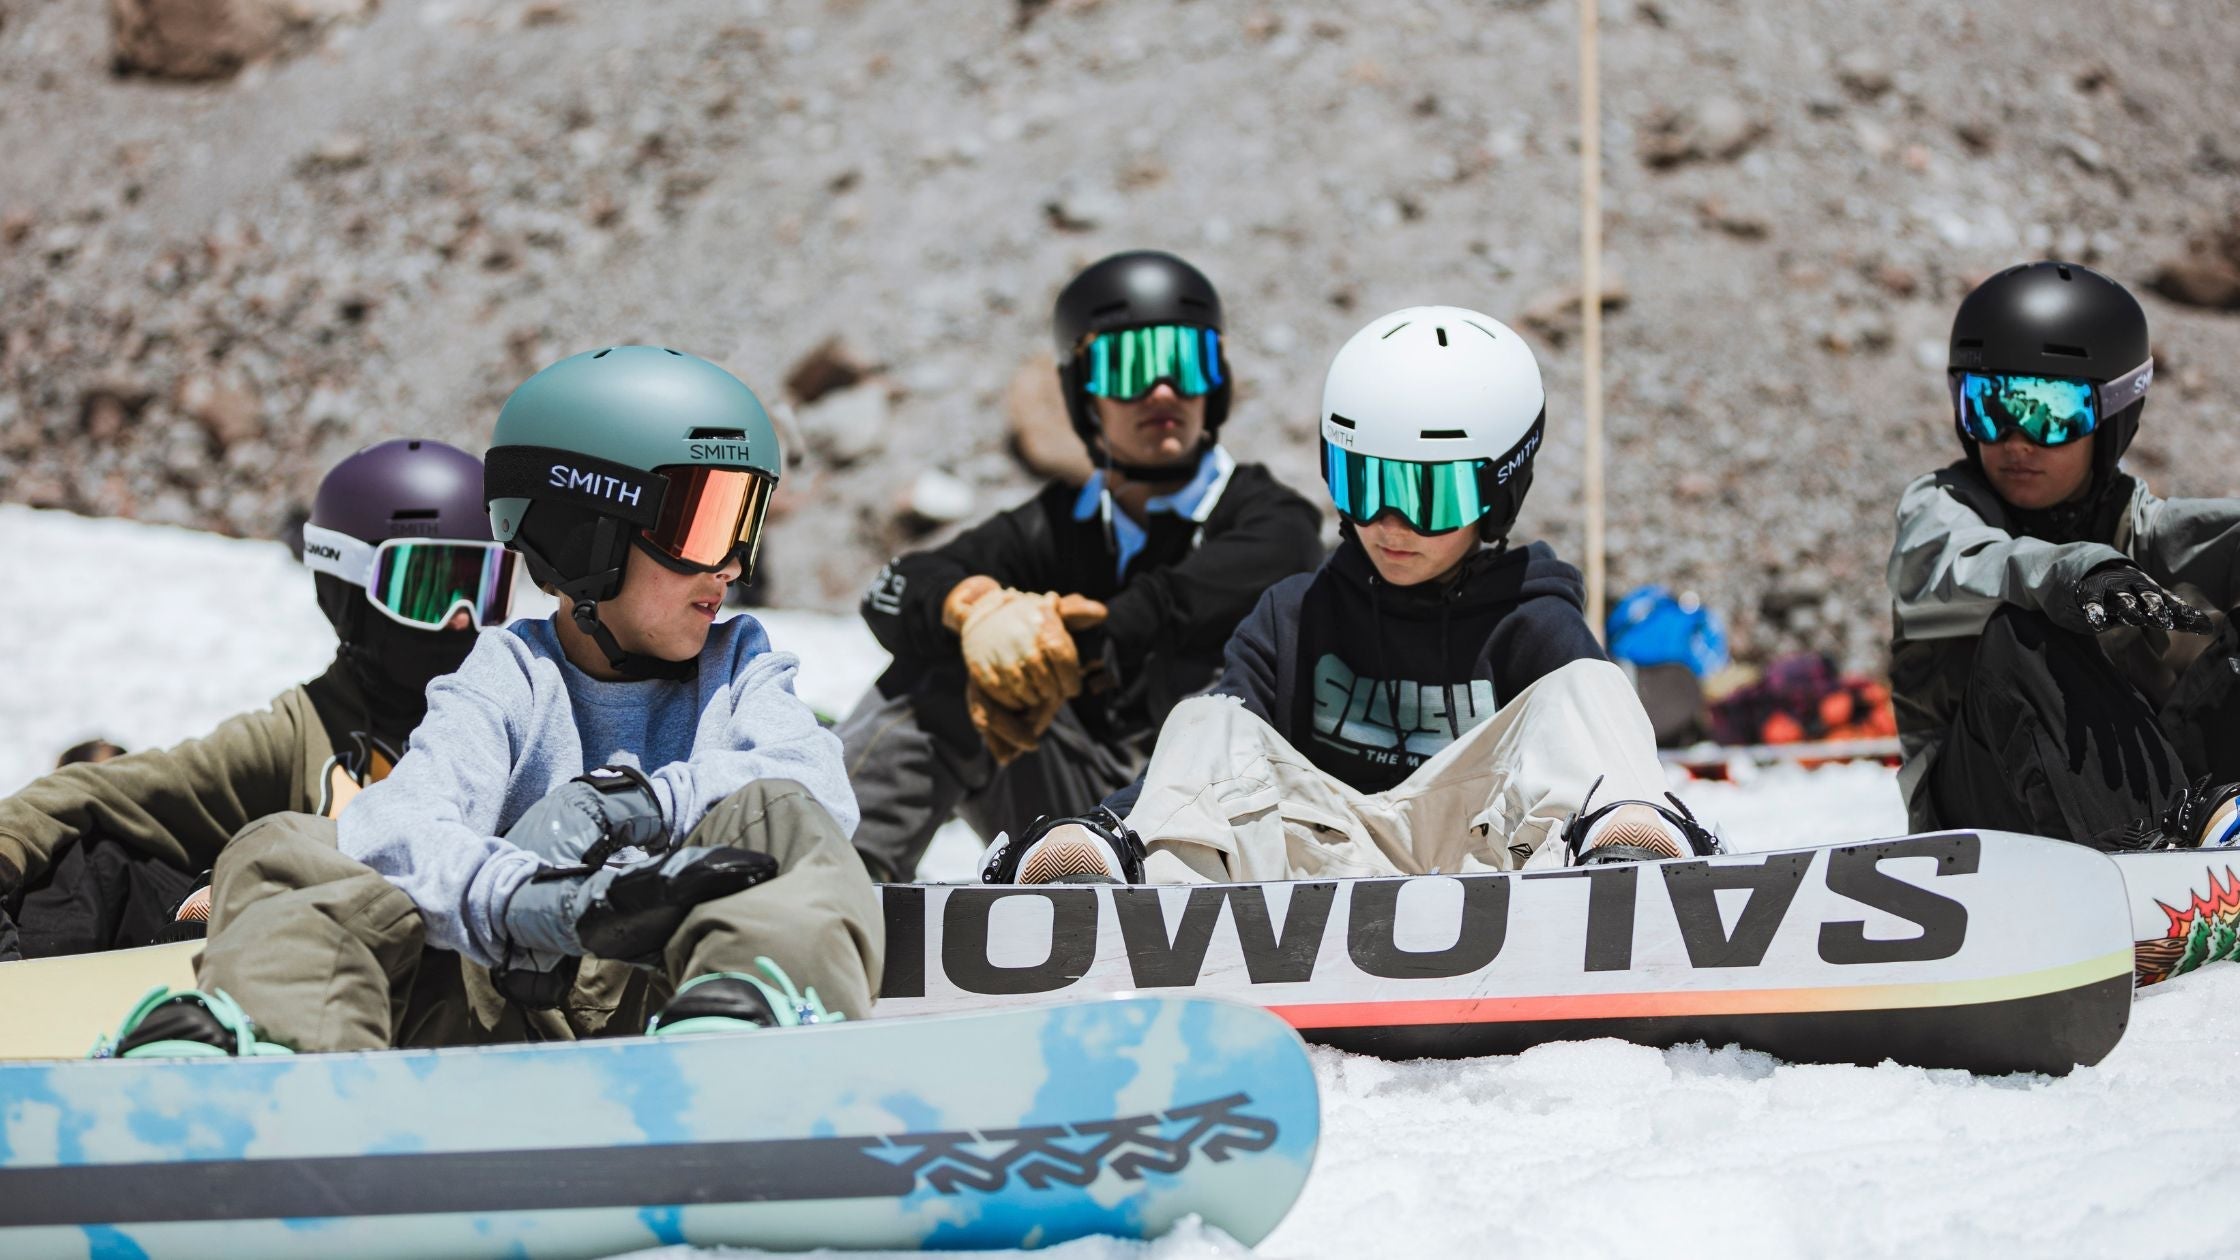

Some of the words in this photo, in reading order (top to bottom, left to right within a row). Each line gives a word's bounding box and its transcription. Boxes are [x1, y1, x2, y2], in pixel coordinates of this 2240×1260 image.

[1328, 425, 1354, 447] SMITH
[690, 444, 749, 461] SMITH
[1497, 430, 1539, 484] SMITH
[549, 464, 642, 506] SMITH
[1366, 749, 1399, 765] THE
